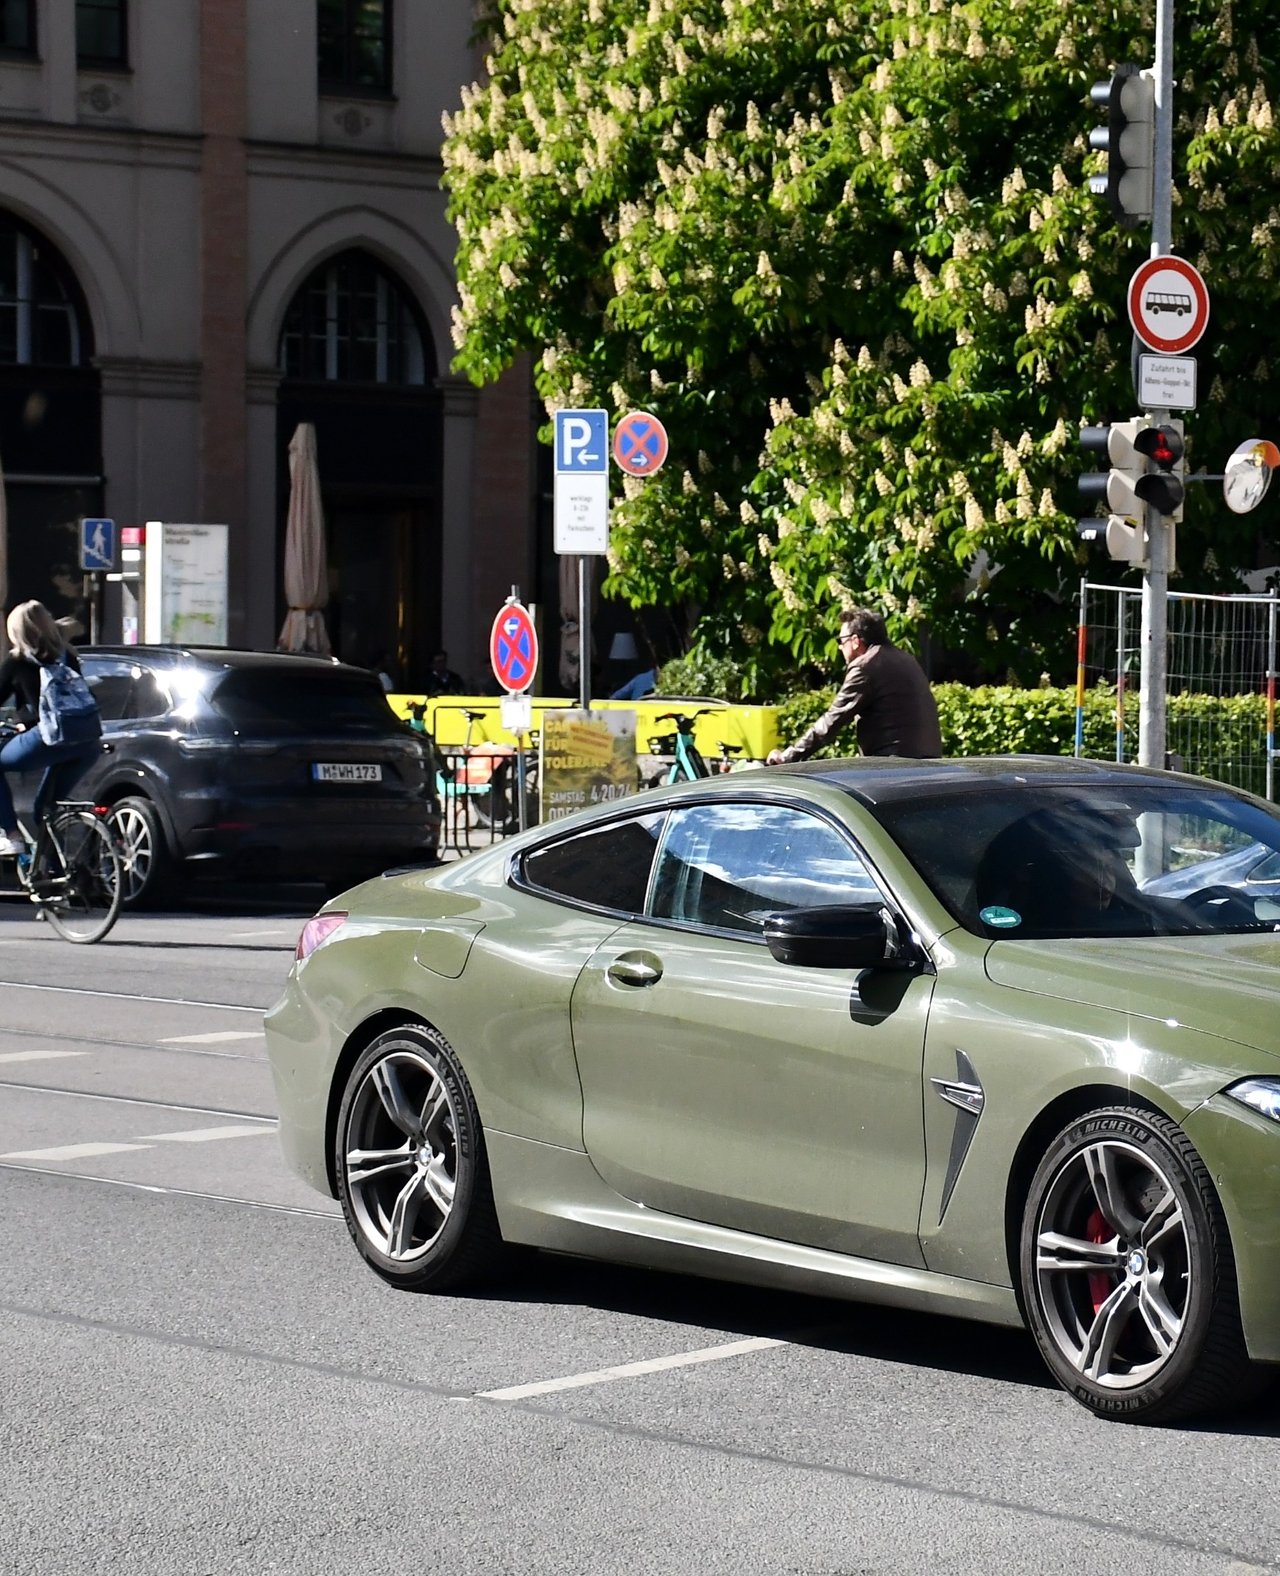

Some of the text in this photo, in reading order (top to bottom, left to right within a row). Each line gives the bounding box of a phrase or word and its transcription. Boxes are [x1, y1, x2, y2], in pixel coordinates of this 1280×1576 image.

[563, 417, 592, 466] P
[322, 765, 377, 779] M WH 173
[549, 790, 586, 804] SAMSTAG
[1085, 1119, 1148, 1141] MICHELIN
